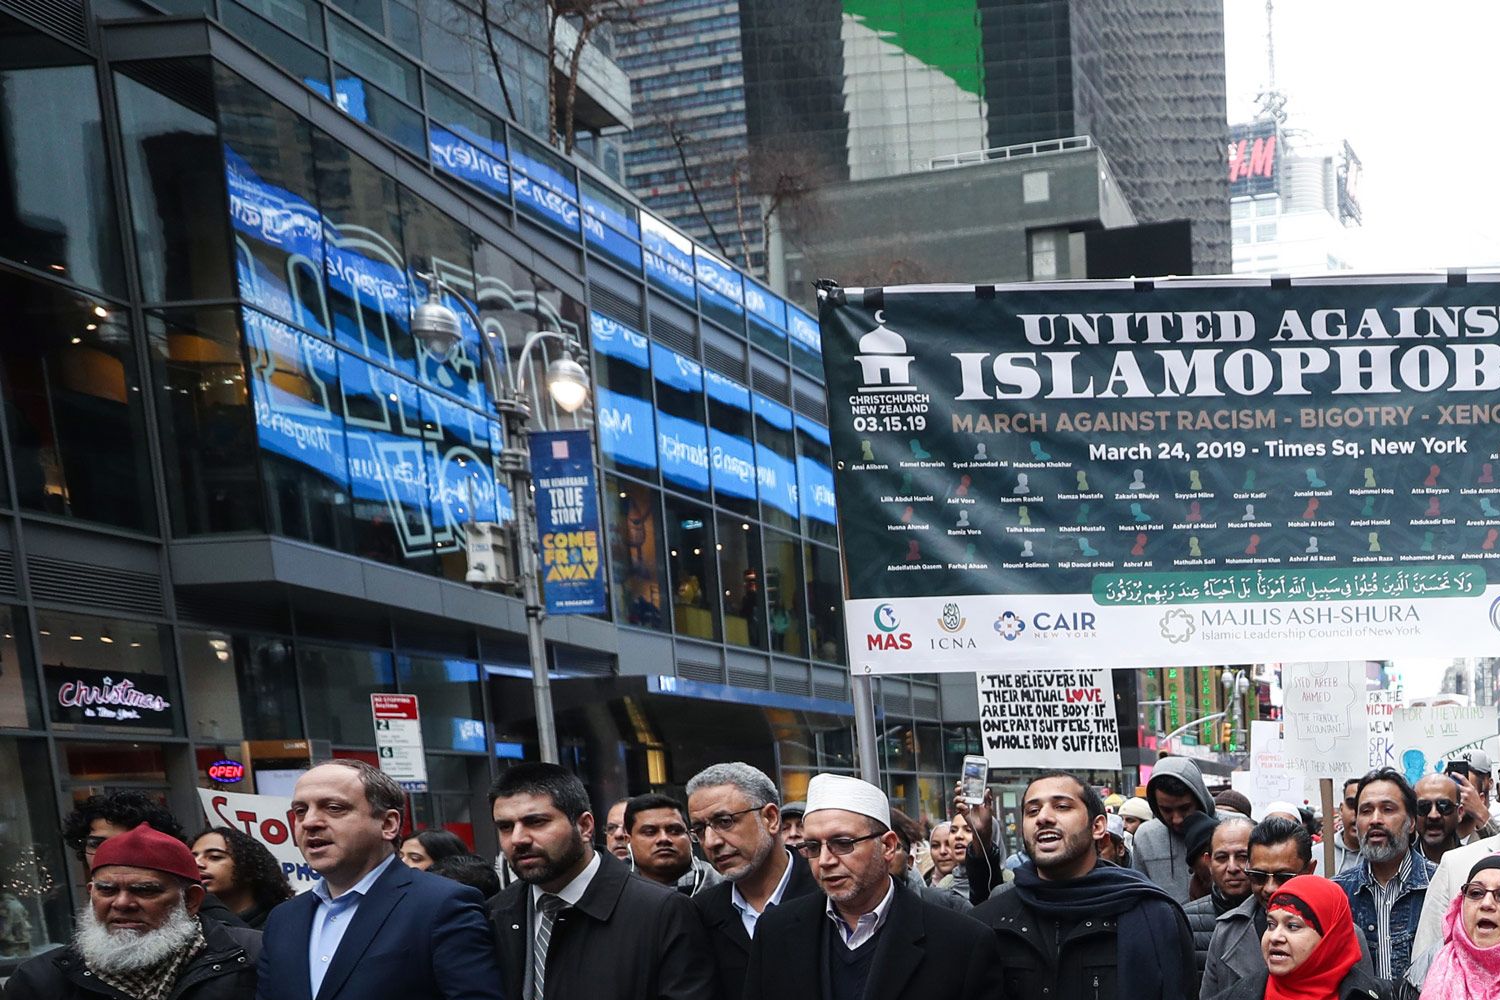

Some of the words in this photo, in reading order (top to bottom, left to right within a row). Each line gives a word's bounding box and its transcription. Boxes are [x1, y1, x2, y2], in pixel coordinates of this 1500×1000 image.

[1016, 311, 1255, 345] UNITED
[849, 394, 930, 405] CHRISTCHURCH
[851, 405, 878, 415] NEW
[880, 404, 929, 414] ZEALAND
[853, 416, 926, 431] 03.15.19
[952, 412, 1048, 433] MARCH
[1056, 411, 1169, 432] AGAINST
[1177, 408, 1276, 431] RACISM
[1300, 406, 1416, 428] BIGOTRY
[1089, 443, 1152, 461] March
[1158, 442, 1191, 461] 24,
[1196, 441, 1246, 459] 2019
[1265, 440, 1326, 457] Times
[1332, 439, 1365, 459] Sq.
[1371, 438, 1416, 455] New
[1421, 436, 1468, 454] York
[549, 487, 585, 508] TRUE
[551, 508, 583, 525] STORY
[542, 531, 597, 549] COME
[546, 562, 598, 582] AWAY
[1033, 612, 1096, 630] CAIR
[1201, 608, 1281, 626] MAJLIS
[1286, 604, 1420, 625] ASH-SHURA
[1202, 629, 1241, 641] Islamic
[1244, 628, 1306, 641] Leadership
[1308, 626, 1352, 638] Council
[1355, 626, 1368, 637] of
[1369, 627, 1393, 637] New
[1394, 625, 1421, 636] York
[867, 633, 912, 650] MAS
[931, 637, 977, 650] ICNA
[1015, 674, 1076, 687] BELIEVERS
[1079, 674, 1093, 687] IN
[58, 678, 170, 711] Christmas
[982, 690, 1019, 702] THEIR
[1021, 689, 1064, 702] MUTUAL
[982, 706, 1006, 717] ARE
[1009, 705, 1034, 717] LIKE
[1036, 705, 1059, 717] ONE
[1095, 704, 1106, 717] IF
[983, 719, 1008, 732] ONE
[1010, 719, 1036, 732] PART
[1094, 719, 1116, 732] THE
[987, 735, 1030, 749] WHOLE
[1033, 734, 1058, 749] BODY
[208, 766, 243, 778] OPEN
